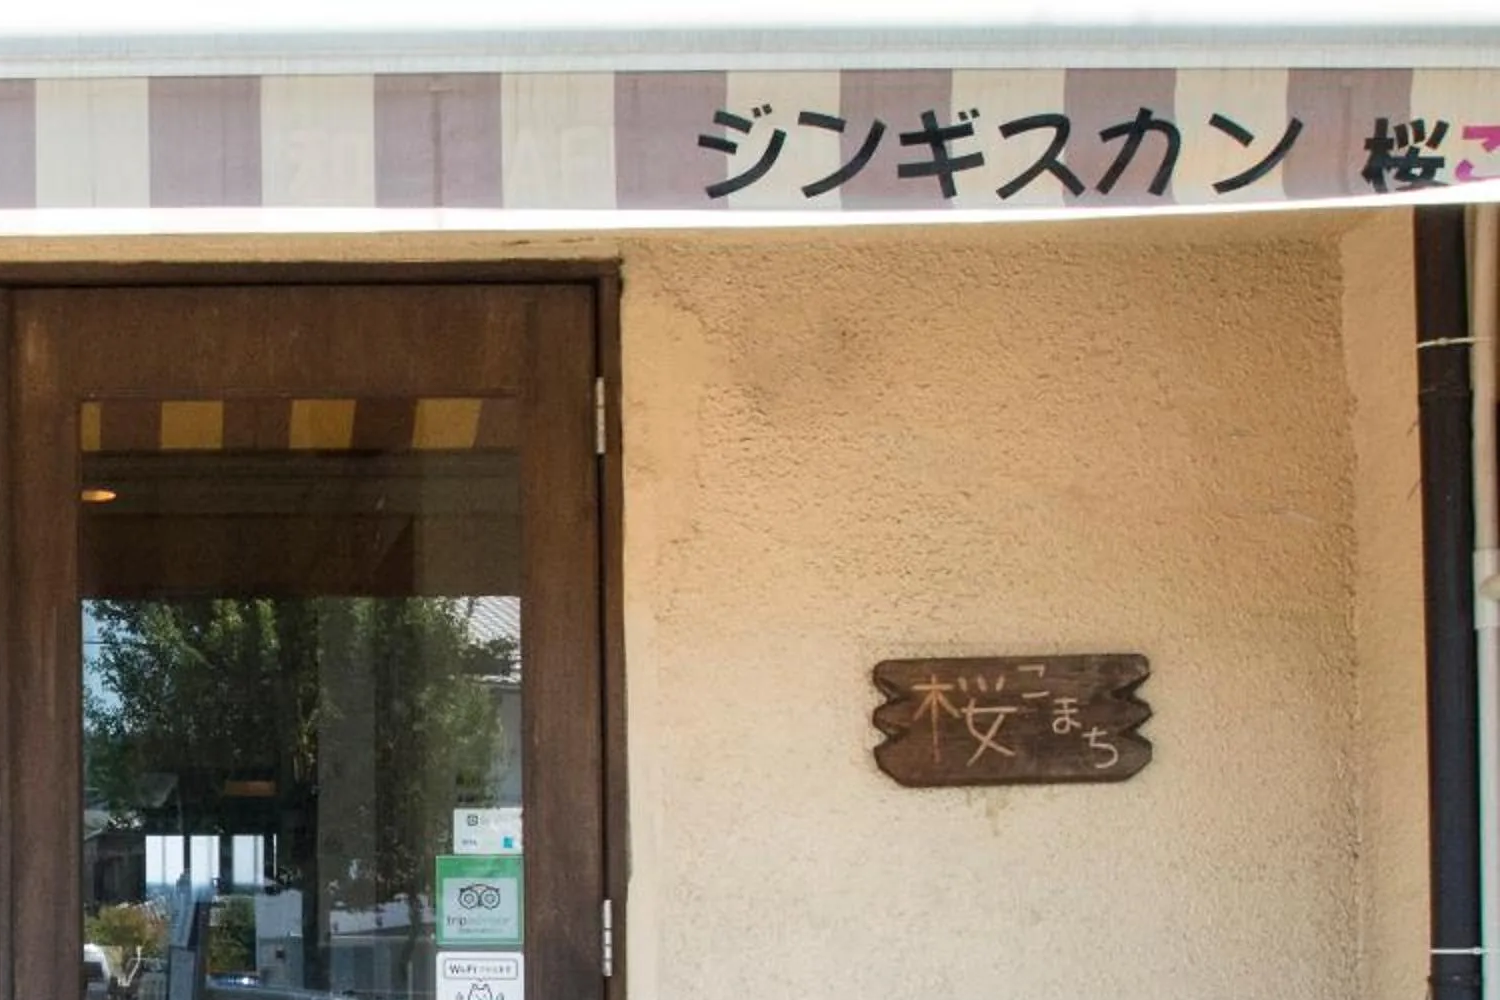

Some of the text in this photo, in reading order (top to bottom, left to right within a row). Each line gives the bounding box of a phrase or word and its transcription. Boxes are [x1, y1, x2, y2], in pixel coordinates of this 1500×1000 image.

[698, 104, 1304, 200] ジンギスカン
[911, 664, 1118, 769] 桜こまち
